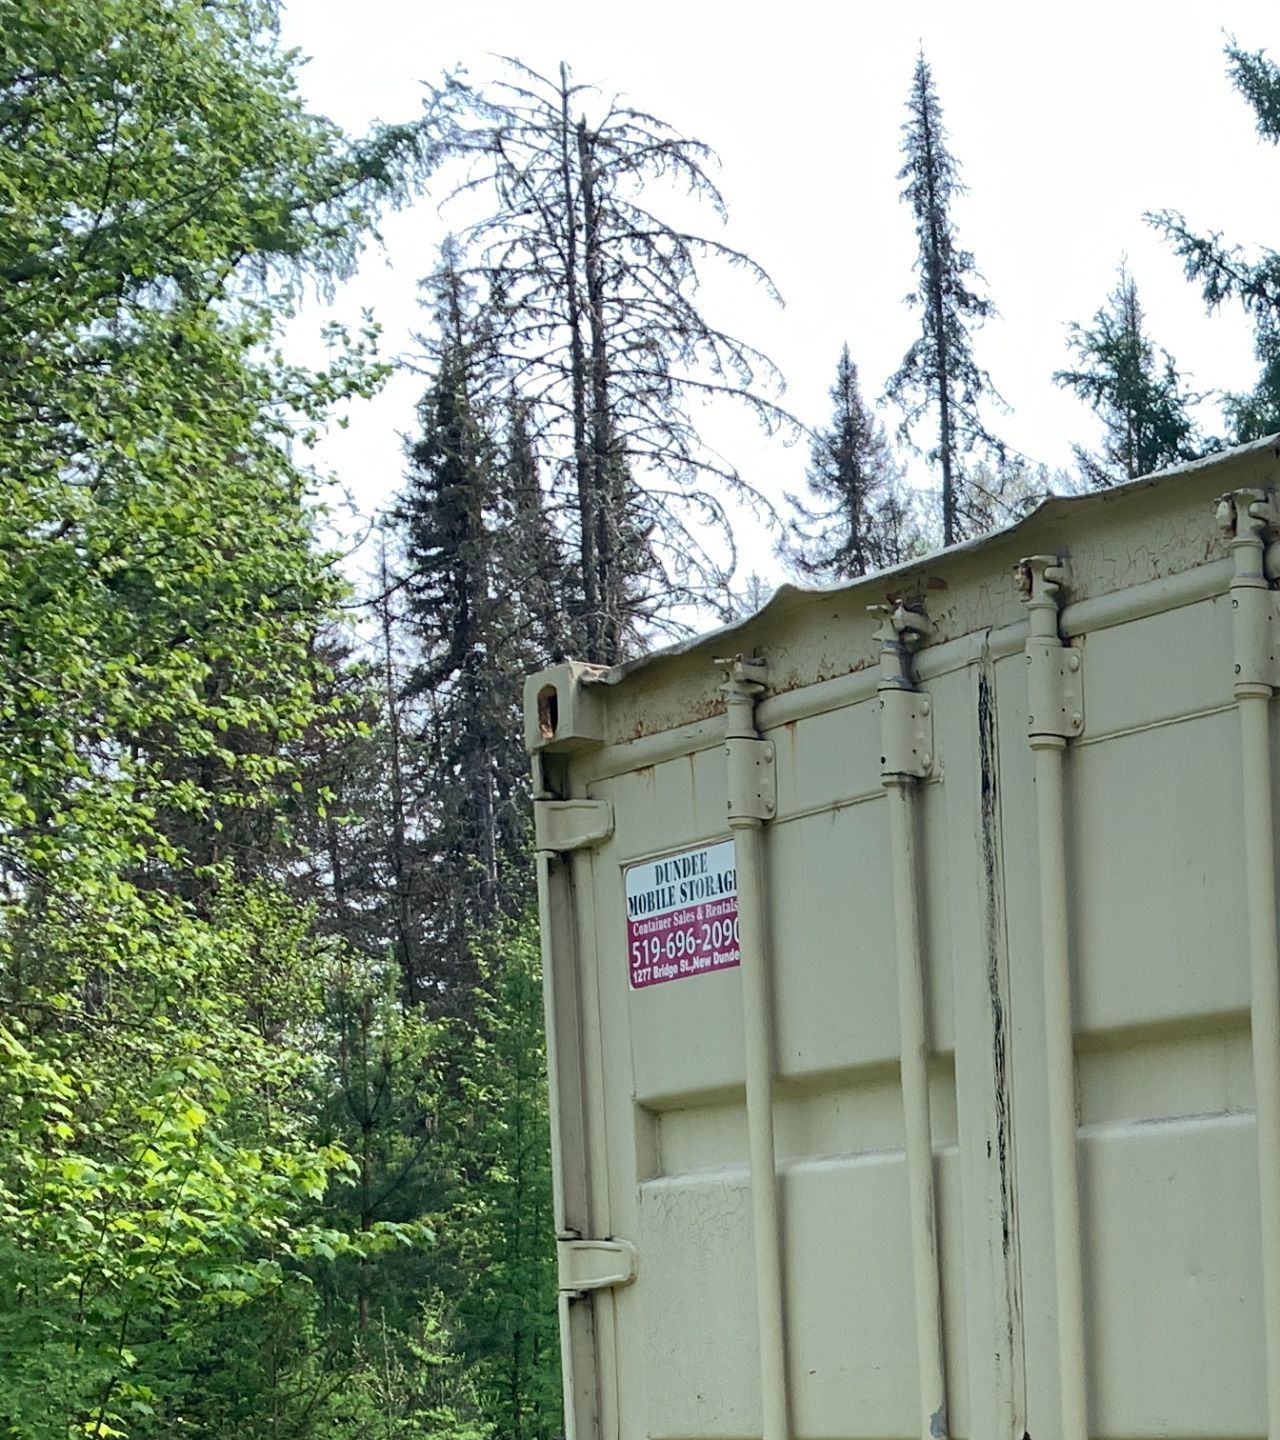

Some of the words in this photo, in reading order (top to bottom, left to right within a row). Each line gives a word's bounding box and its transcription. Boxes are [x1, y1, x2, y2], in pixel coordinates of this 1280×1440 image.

[655, 852, 708, 886] DUNDEE
[628, 885, 676, 917] MOBILE
[633, 917, 672, 937] Container
[674, 909, 696, 926] Sales
[697, 906, 704, 920] &
[706, 899, 739, 918] Rentals
[633, 968, 651, 984] 1277
[653, 962, 679, 980] Bridge
